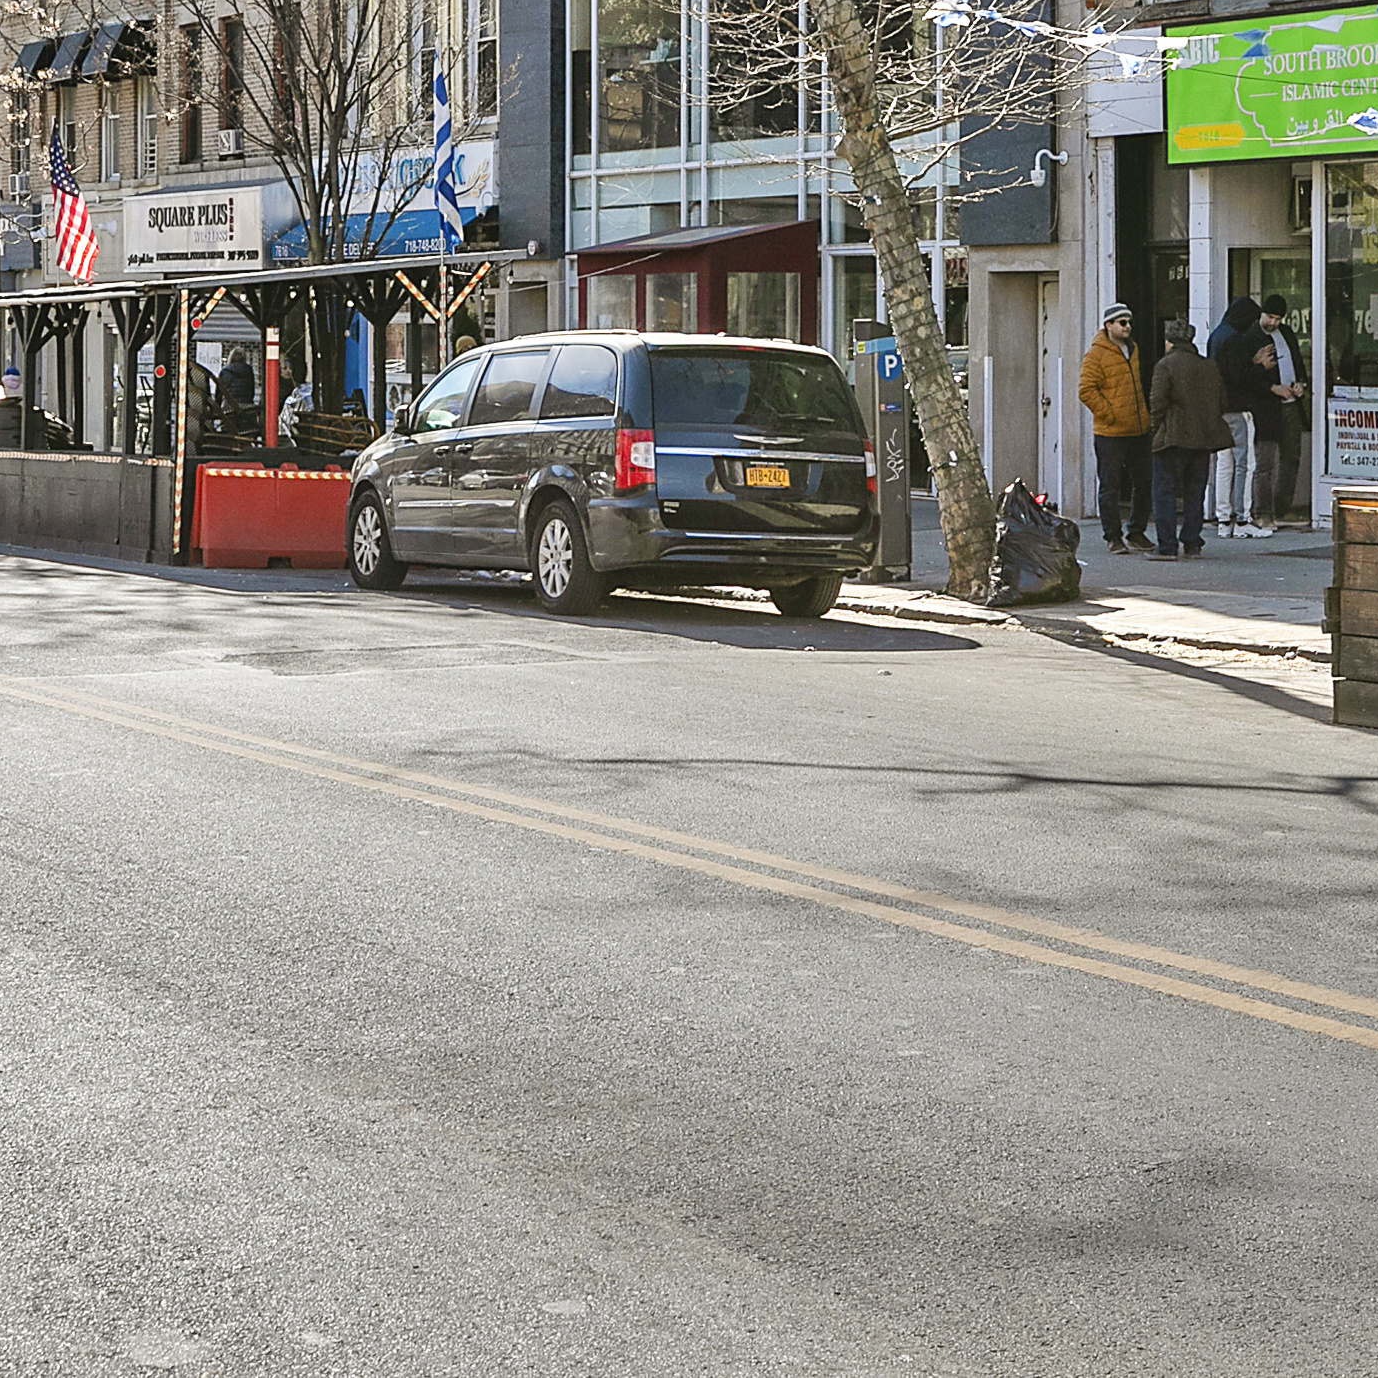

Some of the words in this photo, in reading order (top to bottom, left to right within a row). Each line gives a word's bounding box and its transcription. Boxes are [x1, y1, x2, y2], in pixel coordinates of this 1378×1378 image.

[1263, 50, 1320, 75] SOUTH
[1281, 81, 1338, 102] ISLAMIC
[148, 205, 195, 233] SQUARE
[197, 204, 228, 226] PLUS
[884, 354, 898, 378] P
